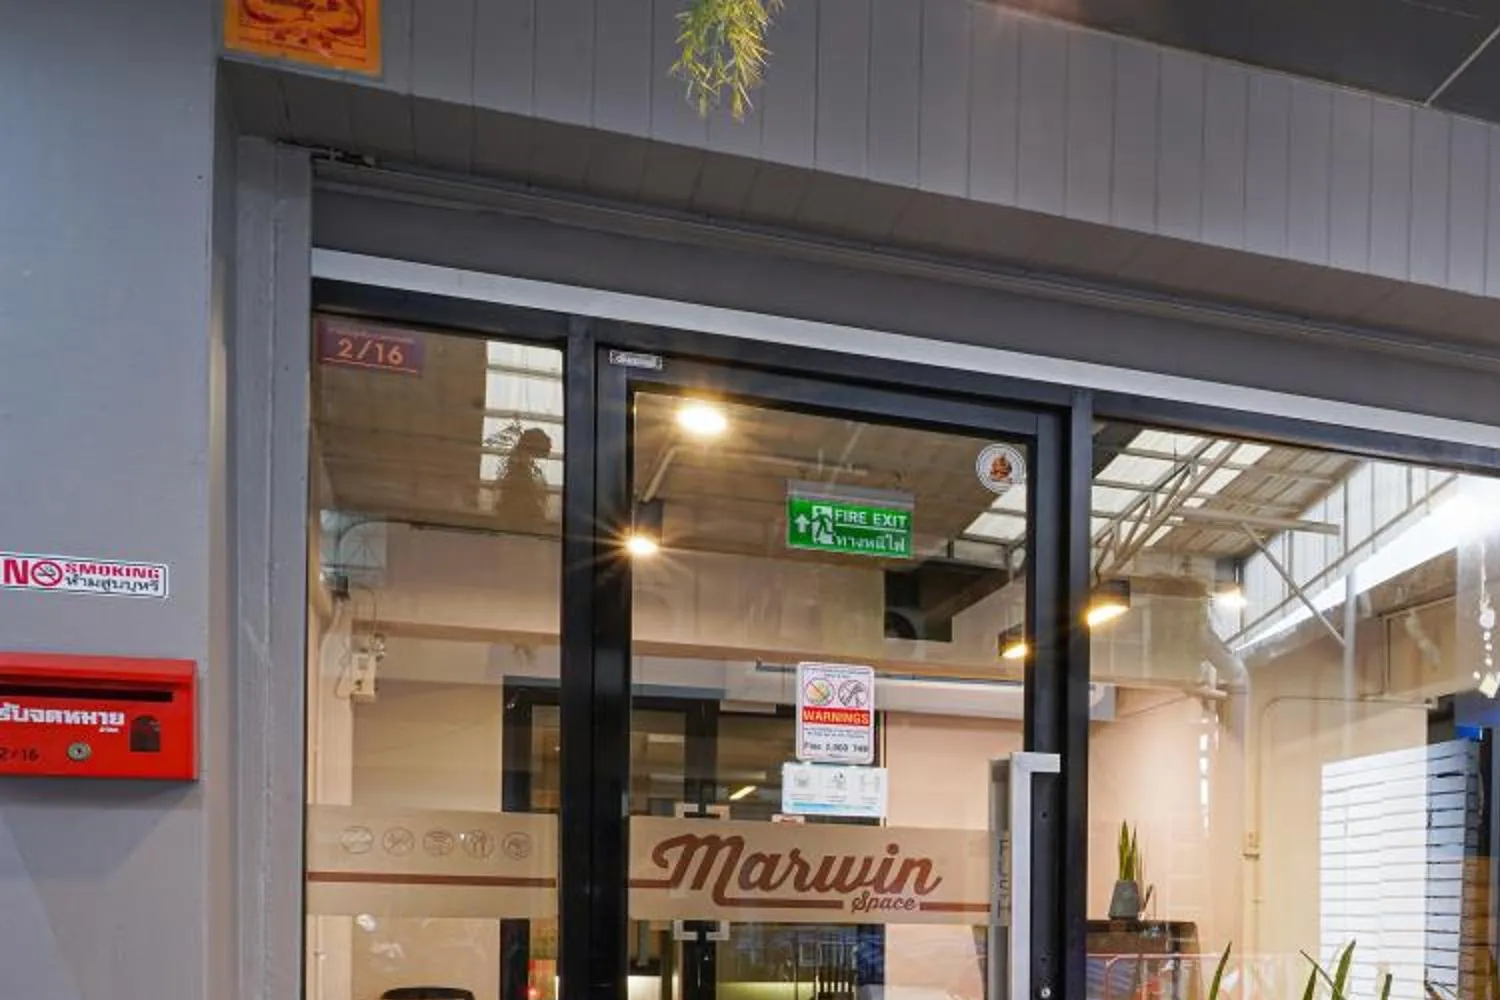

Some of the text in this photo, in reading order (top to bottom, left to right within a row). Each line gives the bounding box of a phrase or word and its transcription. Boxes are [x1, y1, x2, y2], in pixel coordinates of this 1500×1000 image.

[337, 337, 405, 365] 2/16
[835, 509, 908, 529] FIRE EXIT
[65, 563, 160, 579] SMOKING
[803, 709, 870, 724] WARNINGS
[651, 833, 942, 904] Marwin
[851, 892, 917, 913] Space
